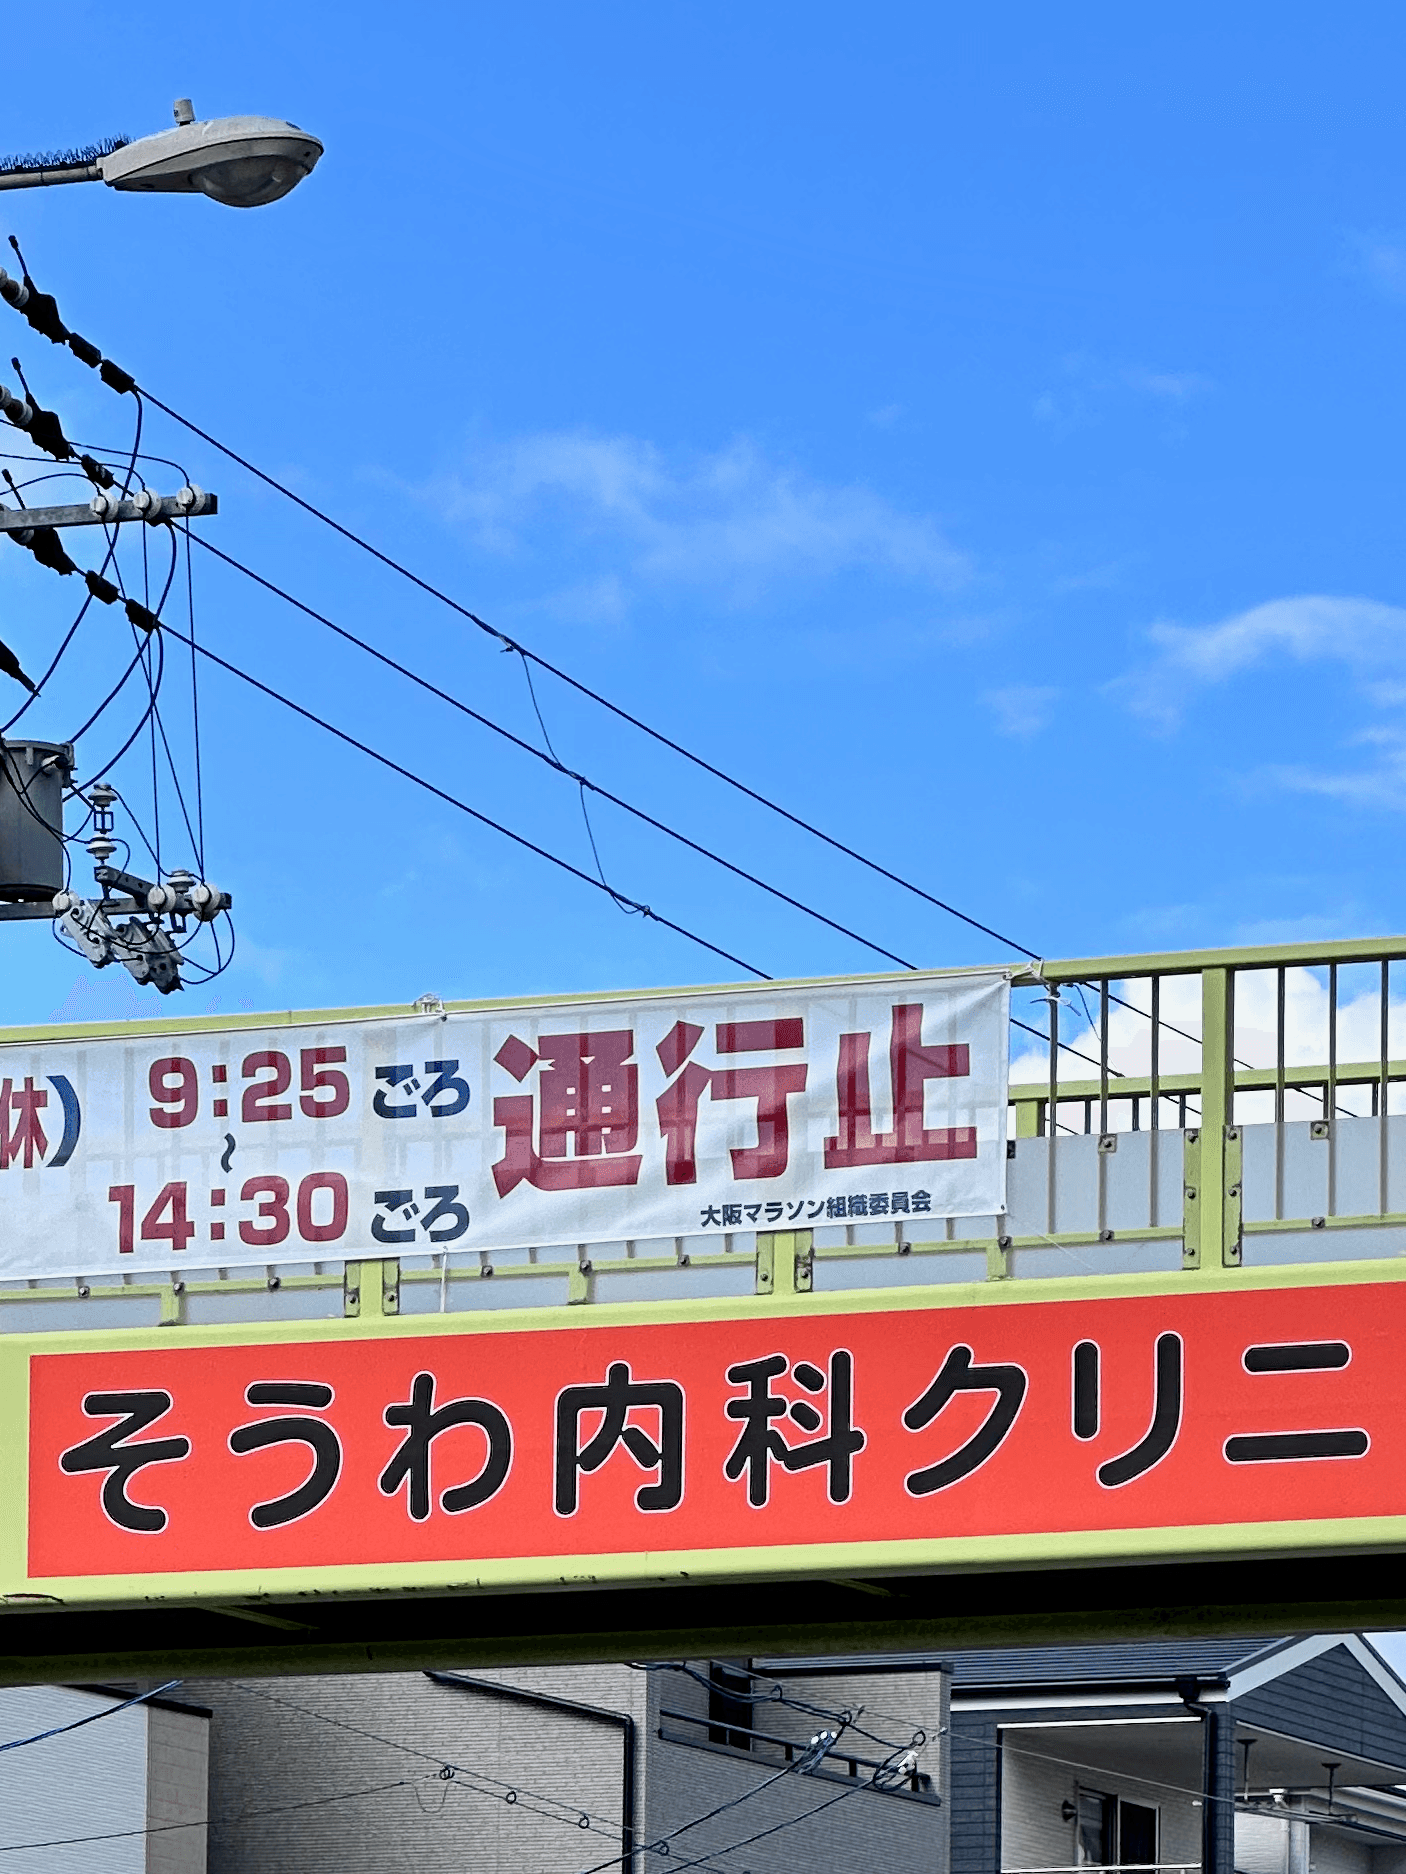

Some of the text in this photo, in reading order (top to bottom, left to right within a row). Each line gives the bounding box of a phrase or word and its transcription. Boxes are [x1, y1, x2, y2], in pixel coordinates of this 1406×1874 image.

[149, 1046, 470, 1128] 9:25 ごろ
[492, 1003, 977, 1198] 通行止
[108, 1171, 469, 1254] 14:30 ごろ
[700, 1189, 931, 1228] 大阪マラソン組織委員会
